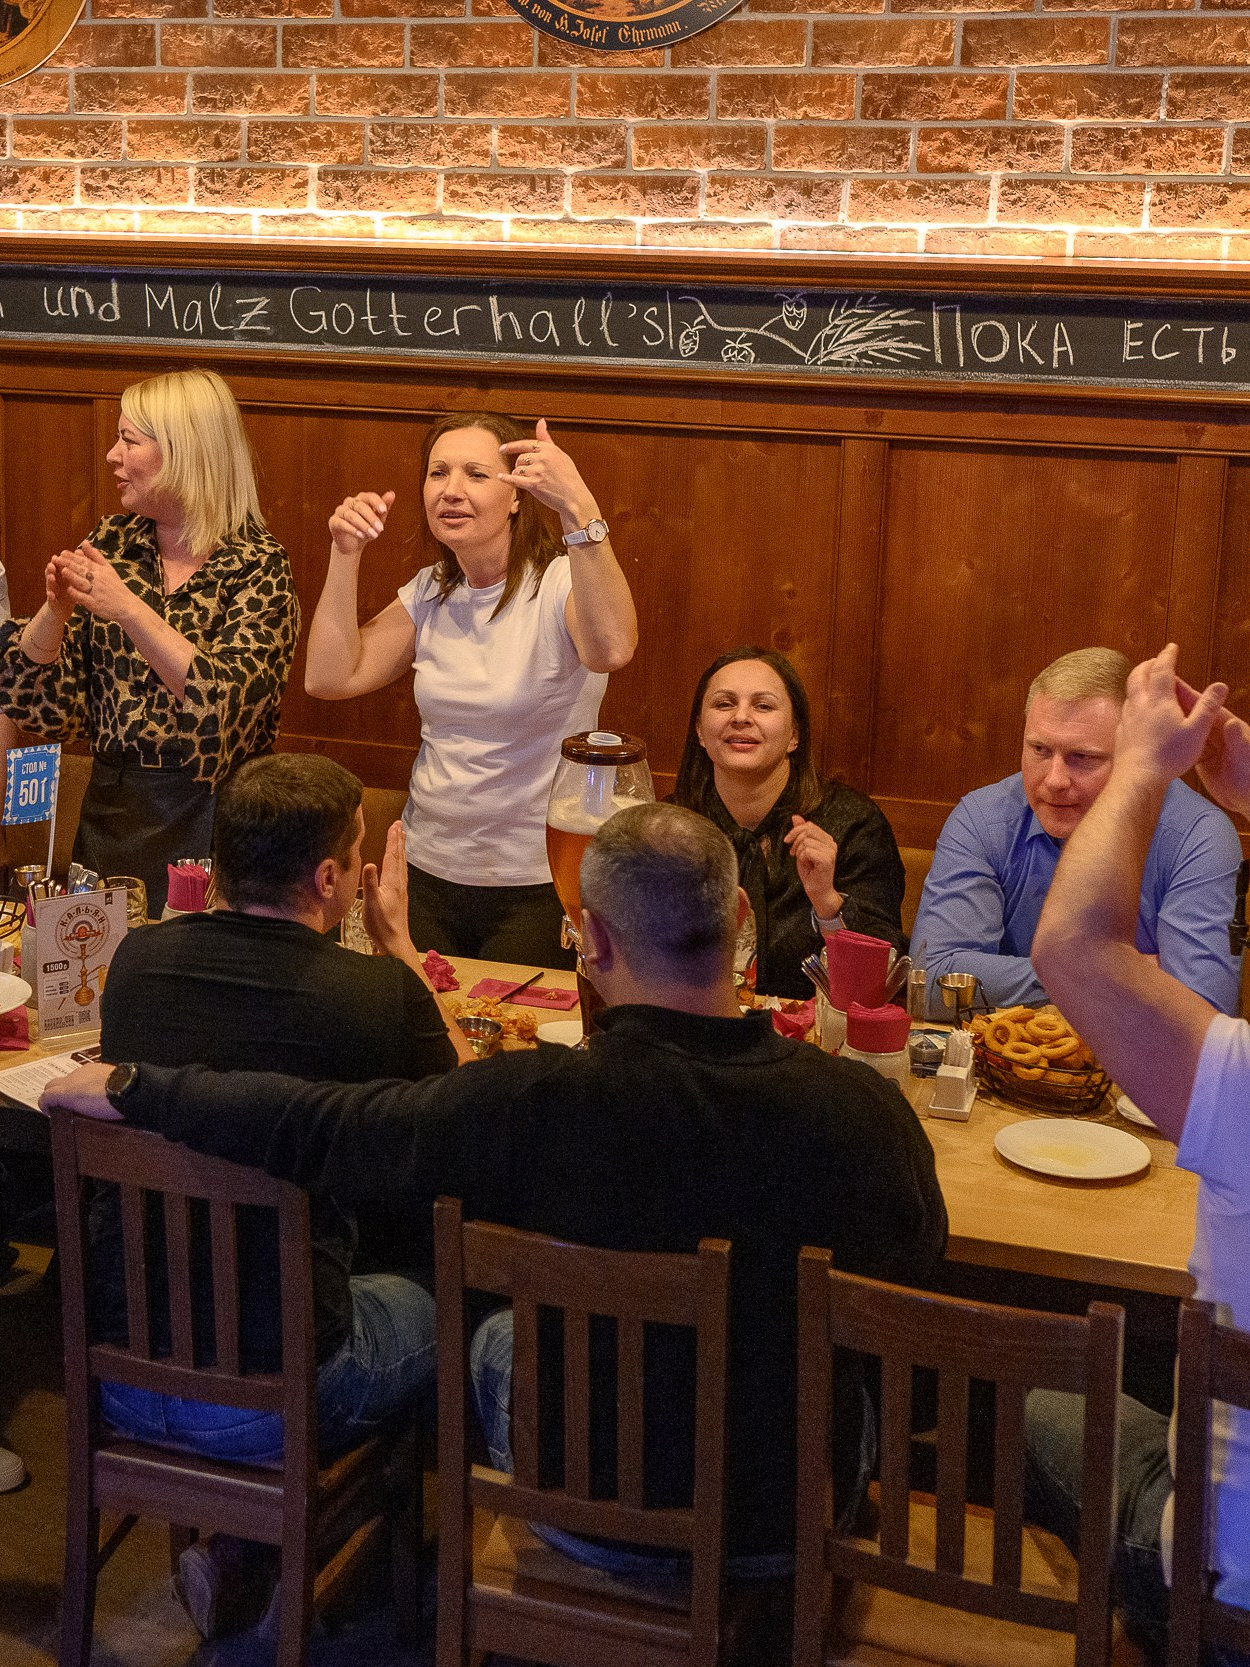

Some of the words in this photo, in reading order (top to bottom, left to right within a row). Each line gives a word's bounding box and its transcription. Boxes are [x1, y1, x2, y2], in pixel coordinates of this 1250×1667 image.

[531, 4, 551, 23] von
[44, 278, 121, 322] und
[145, 281, 271, 334] Malz
[932, 302, 1074, 368] ПОКА
[1123, 320, 1237, 365] ЕСТЬ
[22, 762, 37, 774] СТОЛ
[18, 777, 48, 806] 501
